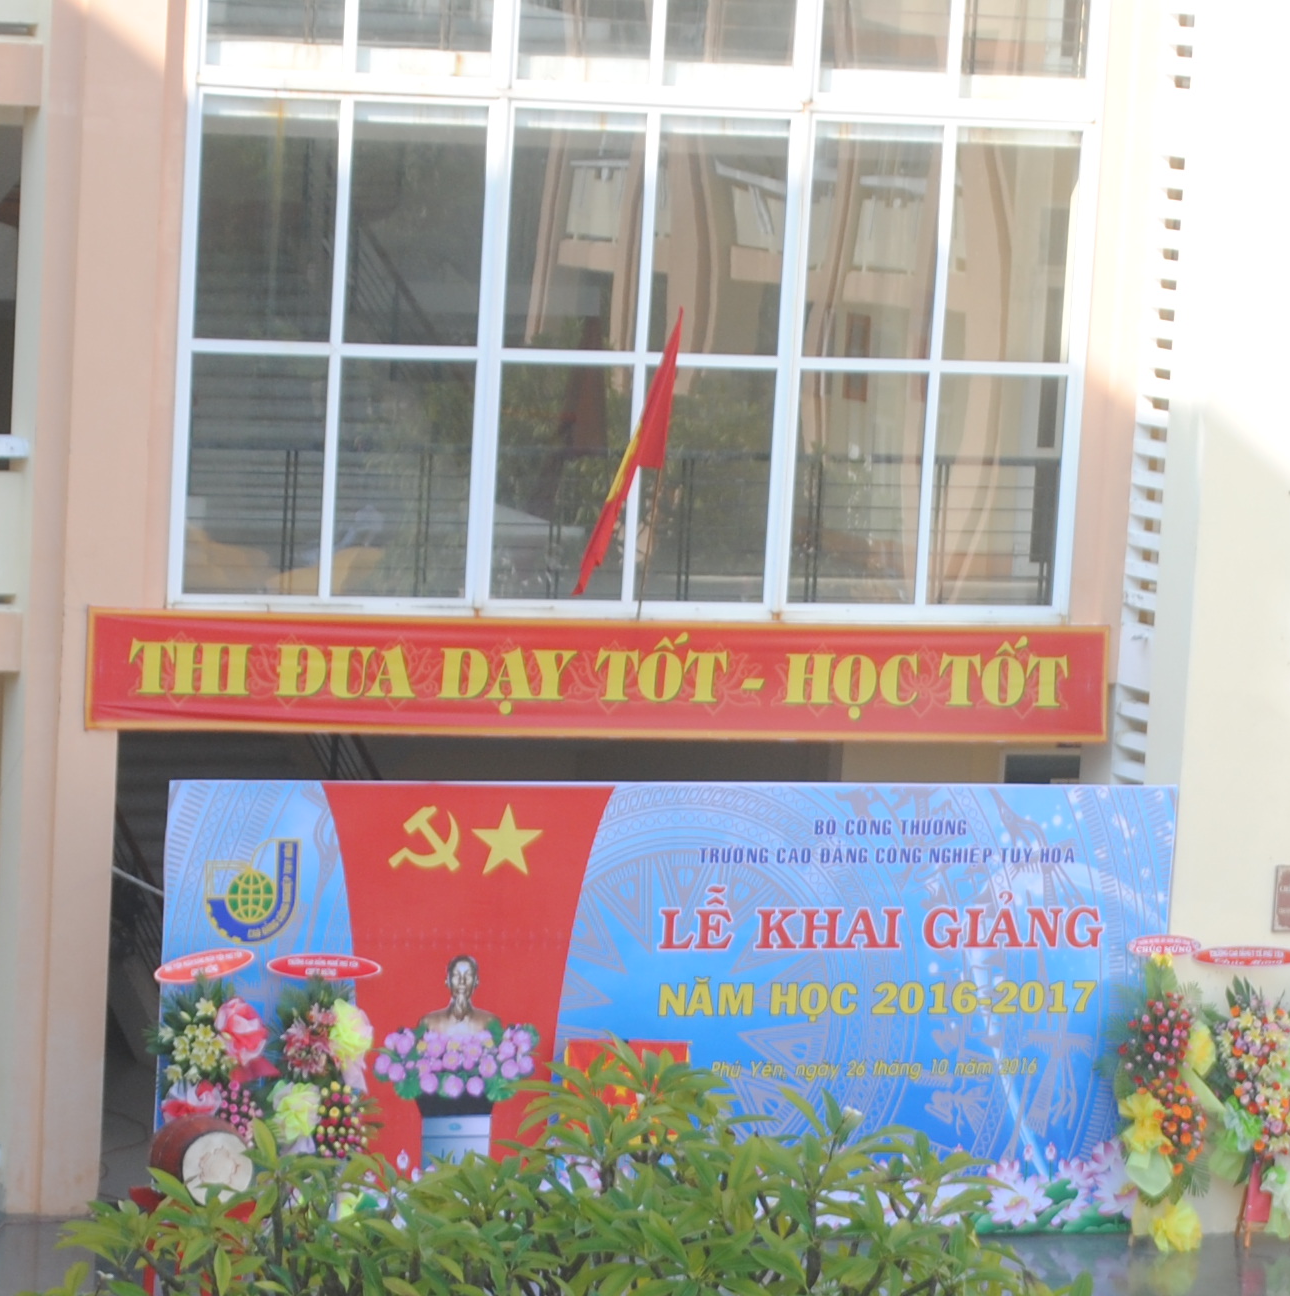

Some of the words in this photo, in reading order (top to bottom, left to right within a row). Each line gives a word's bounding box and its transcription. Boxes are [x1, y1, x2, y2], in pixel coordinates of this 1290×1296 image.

[130, 639, 249, 696] THI
[276, 642, 416, 699] ĐUA
[440, 646, 579, 715] DẠY
[596, 630, 730, 703] TỐT
[786, 650, 921, 721] HỌC
[939, 634, 1070, 710] TỐT
[814, 816, 837, 839] BỘ
[845, 815, 893, 836] CÔNG
[900, 817, 968, 836] THƯƠNG
[699, 843, 769, 864] TRƯỜNG
[776, 847, 811, 864] CAO
[818, 840, 869, 865] ĐẲNG
[875, 844, 923, 865] CÔNG
[999, 847, 1033, 865] TUY
[658, 884, 735, 951] LỄ
[754, 906, 904, 951] KHAI
[922, 890, 1103, 951] GIẢNG
[658, 976, 755, 1017] NĂM
[769, 981, 859, 1023] HỌC
[871, 980, 1098, 1017] 2016-2017
[711, 1060, 742, 1079] Phú
[794, 1060, 840, 1082] ngày
[846, 1059, 867, 1077] 26
[873, 1058, 922, 1082] tháng
[931, 1058, 950, 1075] 10
[954, 1058, 993, 1077] năm
[998, 1056, 1038, 1075] 2016
